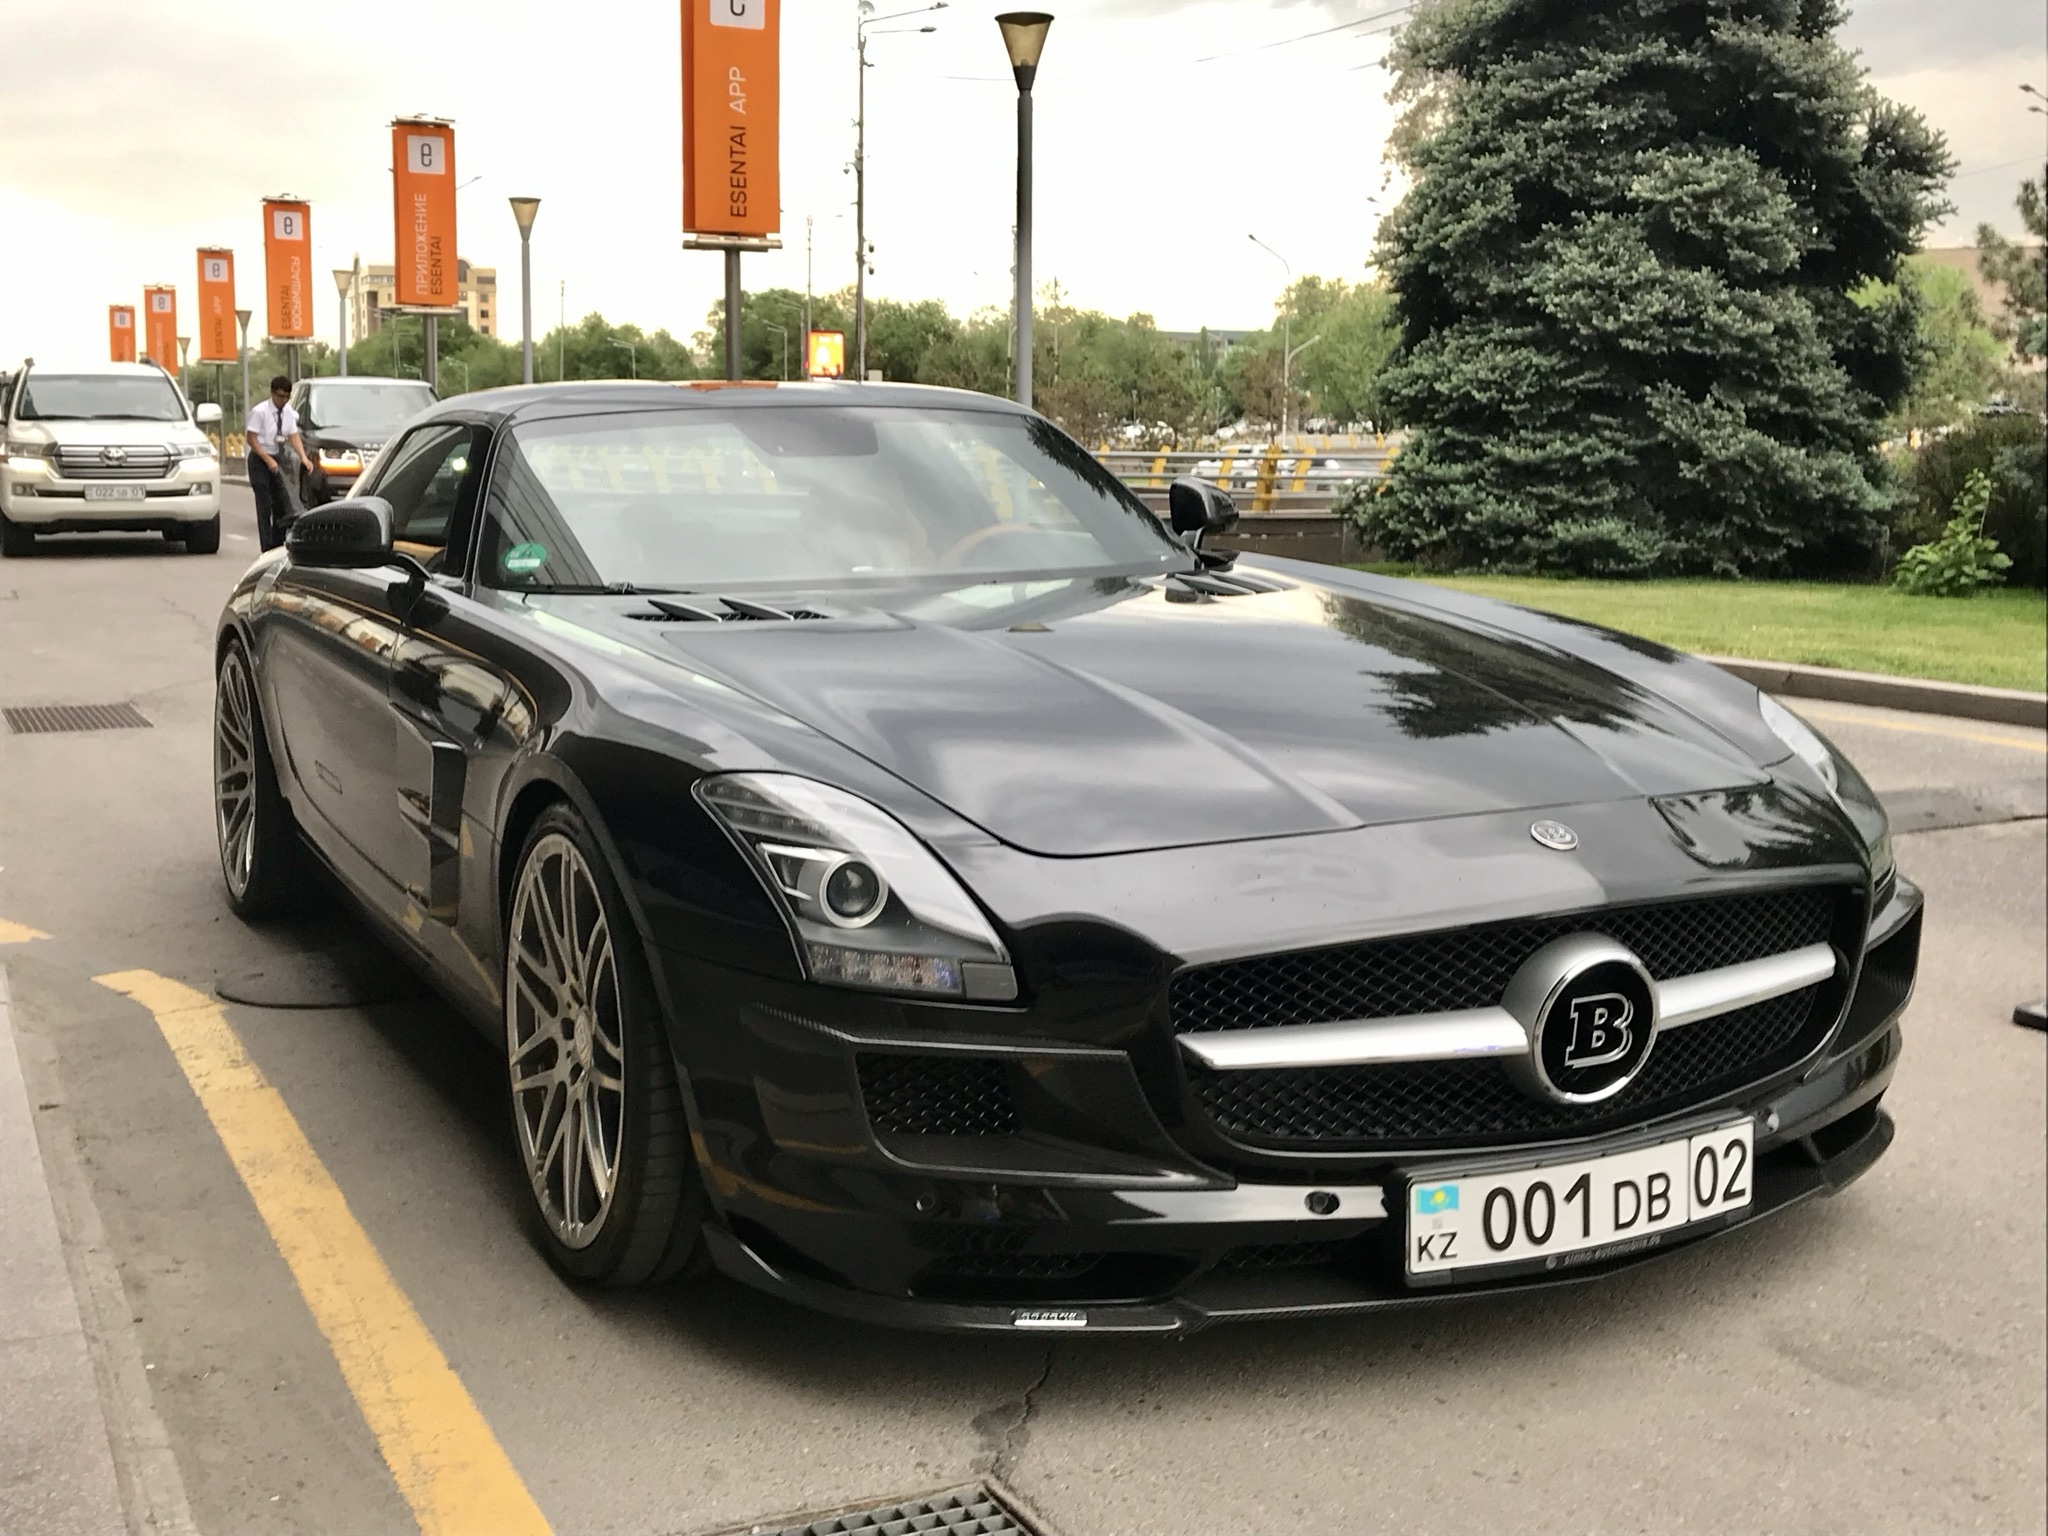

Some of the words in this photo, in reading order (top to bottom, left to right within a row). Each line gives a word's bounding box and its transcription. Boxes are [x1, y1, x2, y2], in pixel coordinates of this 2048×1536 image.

[729, 66, 747, 115] APP
[729, 125, 747, 218] ESENTAI
[414, 193, 428, 295] ПРИЛОЖЕНИЕ
[430, 236, 443, 296] ESENTAI
[280, 284, 291, 330] ESENTAI
[95, 487, 114, 497] 022
[1564, 992, 1635, 1069] B
[1482, 1172, 1592, 1252] 001
[1613, 1171, 1672, 1232] DB
[1694, 1138, 1748, 1208] 02
[1416, 1231, 1459, 1263] KZ
